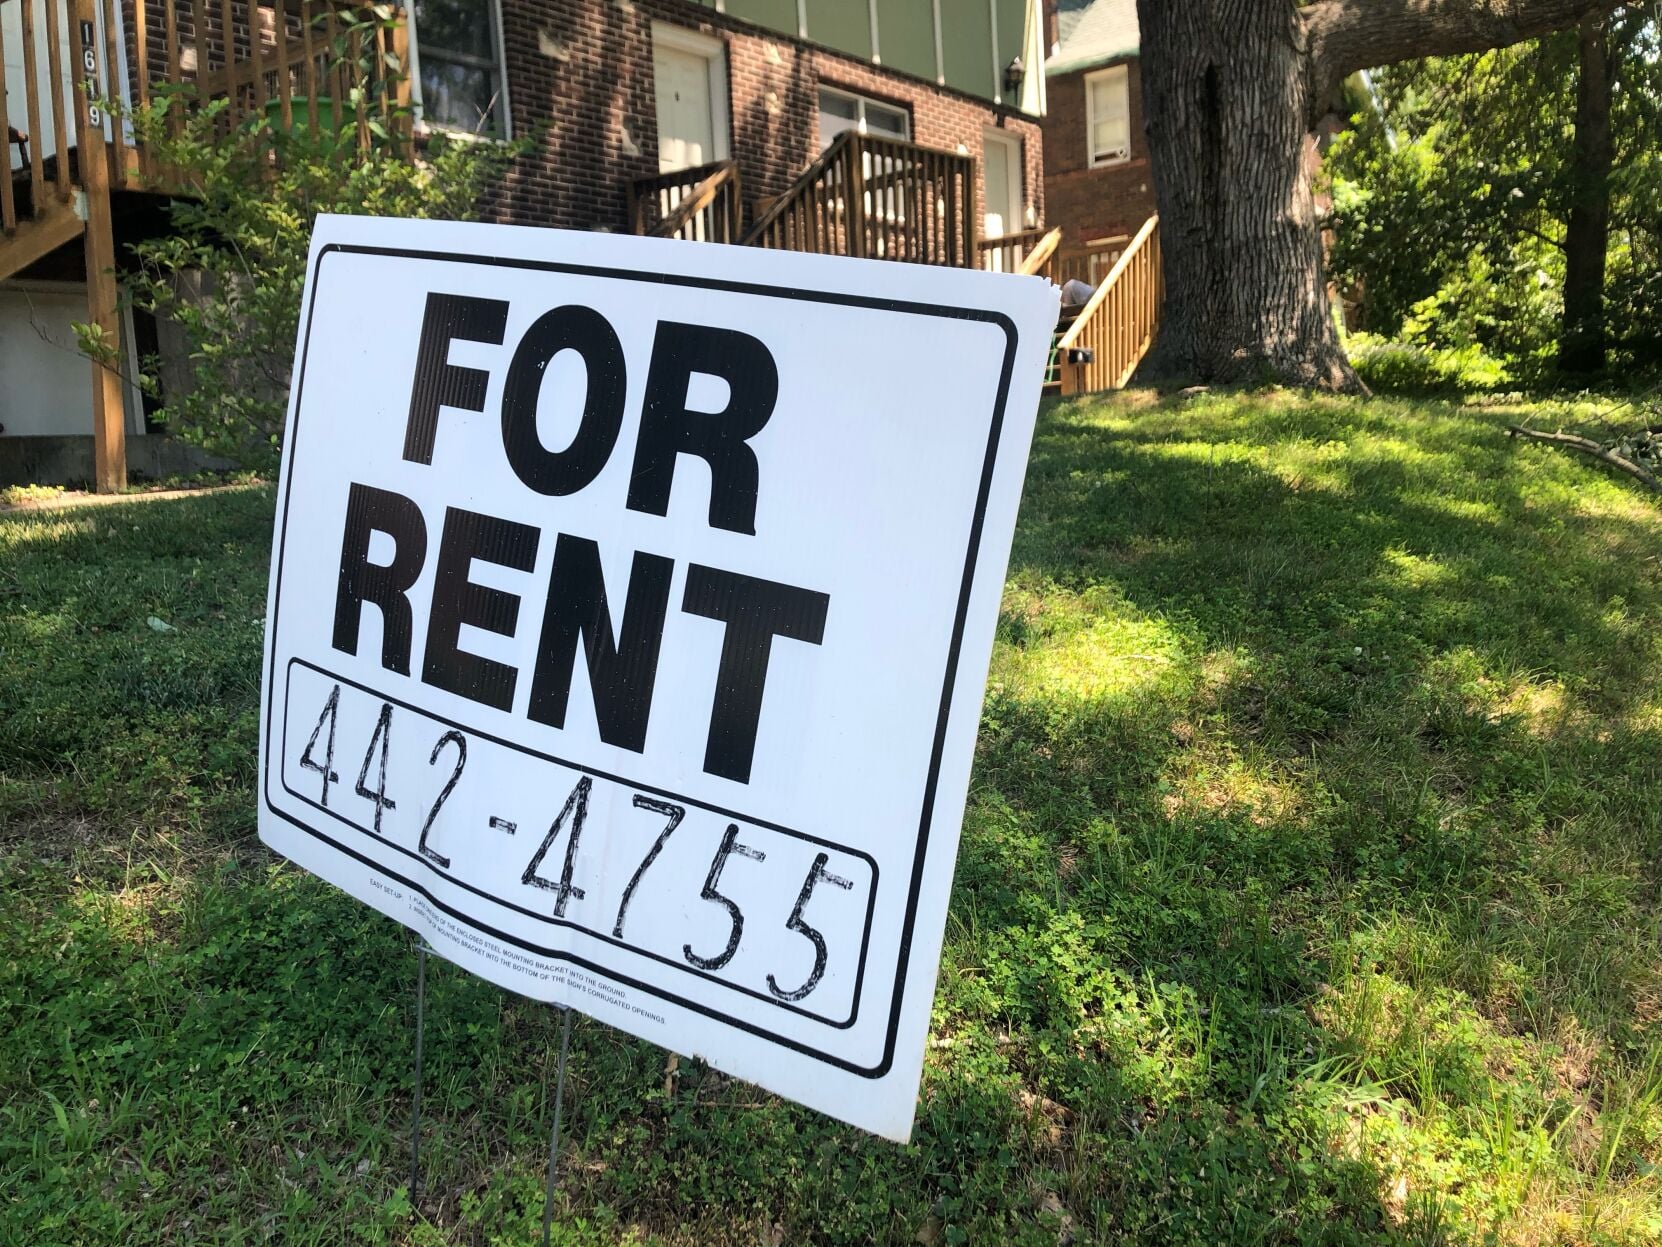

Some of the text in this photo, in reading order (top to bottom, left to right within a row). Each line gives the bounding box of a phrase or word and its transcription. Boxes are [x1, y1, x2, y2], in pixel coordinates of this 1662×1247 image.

[83, 23, 101, 127] 1619
[402, 291, 779, 536] FOR
[332, 482, 831, 785] RENT
[300, 684, 854, 1001] 442-4755
[370, 878, 383, 890] EASY
[438, 925, 460, 944] MOUNTING
[461, 940, 485, 956] BRACKET
[486, 952, 499, 963] INTO
[500, 958, 512, 969] THE
[512, 963, 539, 978] BOTTOM
[540, 973, 550, 981] OF
[552, 975, 565, 984] THE
[587, 987, 631, 1010] CORRUGATED
[447, 922, 456, 931] THE
[456, 927, 484, 946] ENCLOSED
[484, 941, 501, 954] STEEL
[502, 948, 534, 966] MOUNTING
[535, 961, 568, 974] BRACKET
[570, 970, 584, 981] INTO
[585, 976, 597, 987] THE
